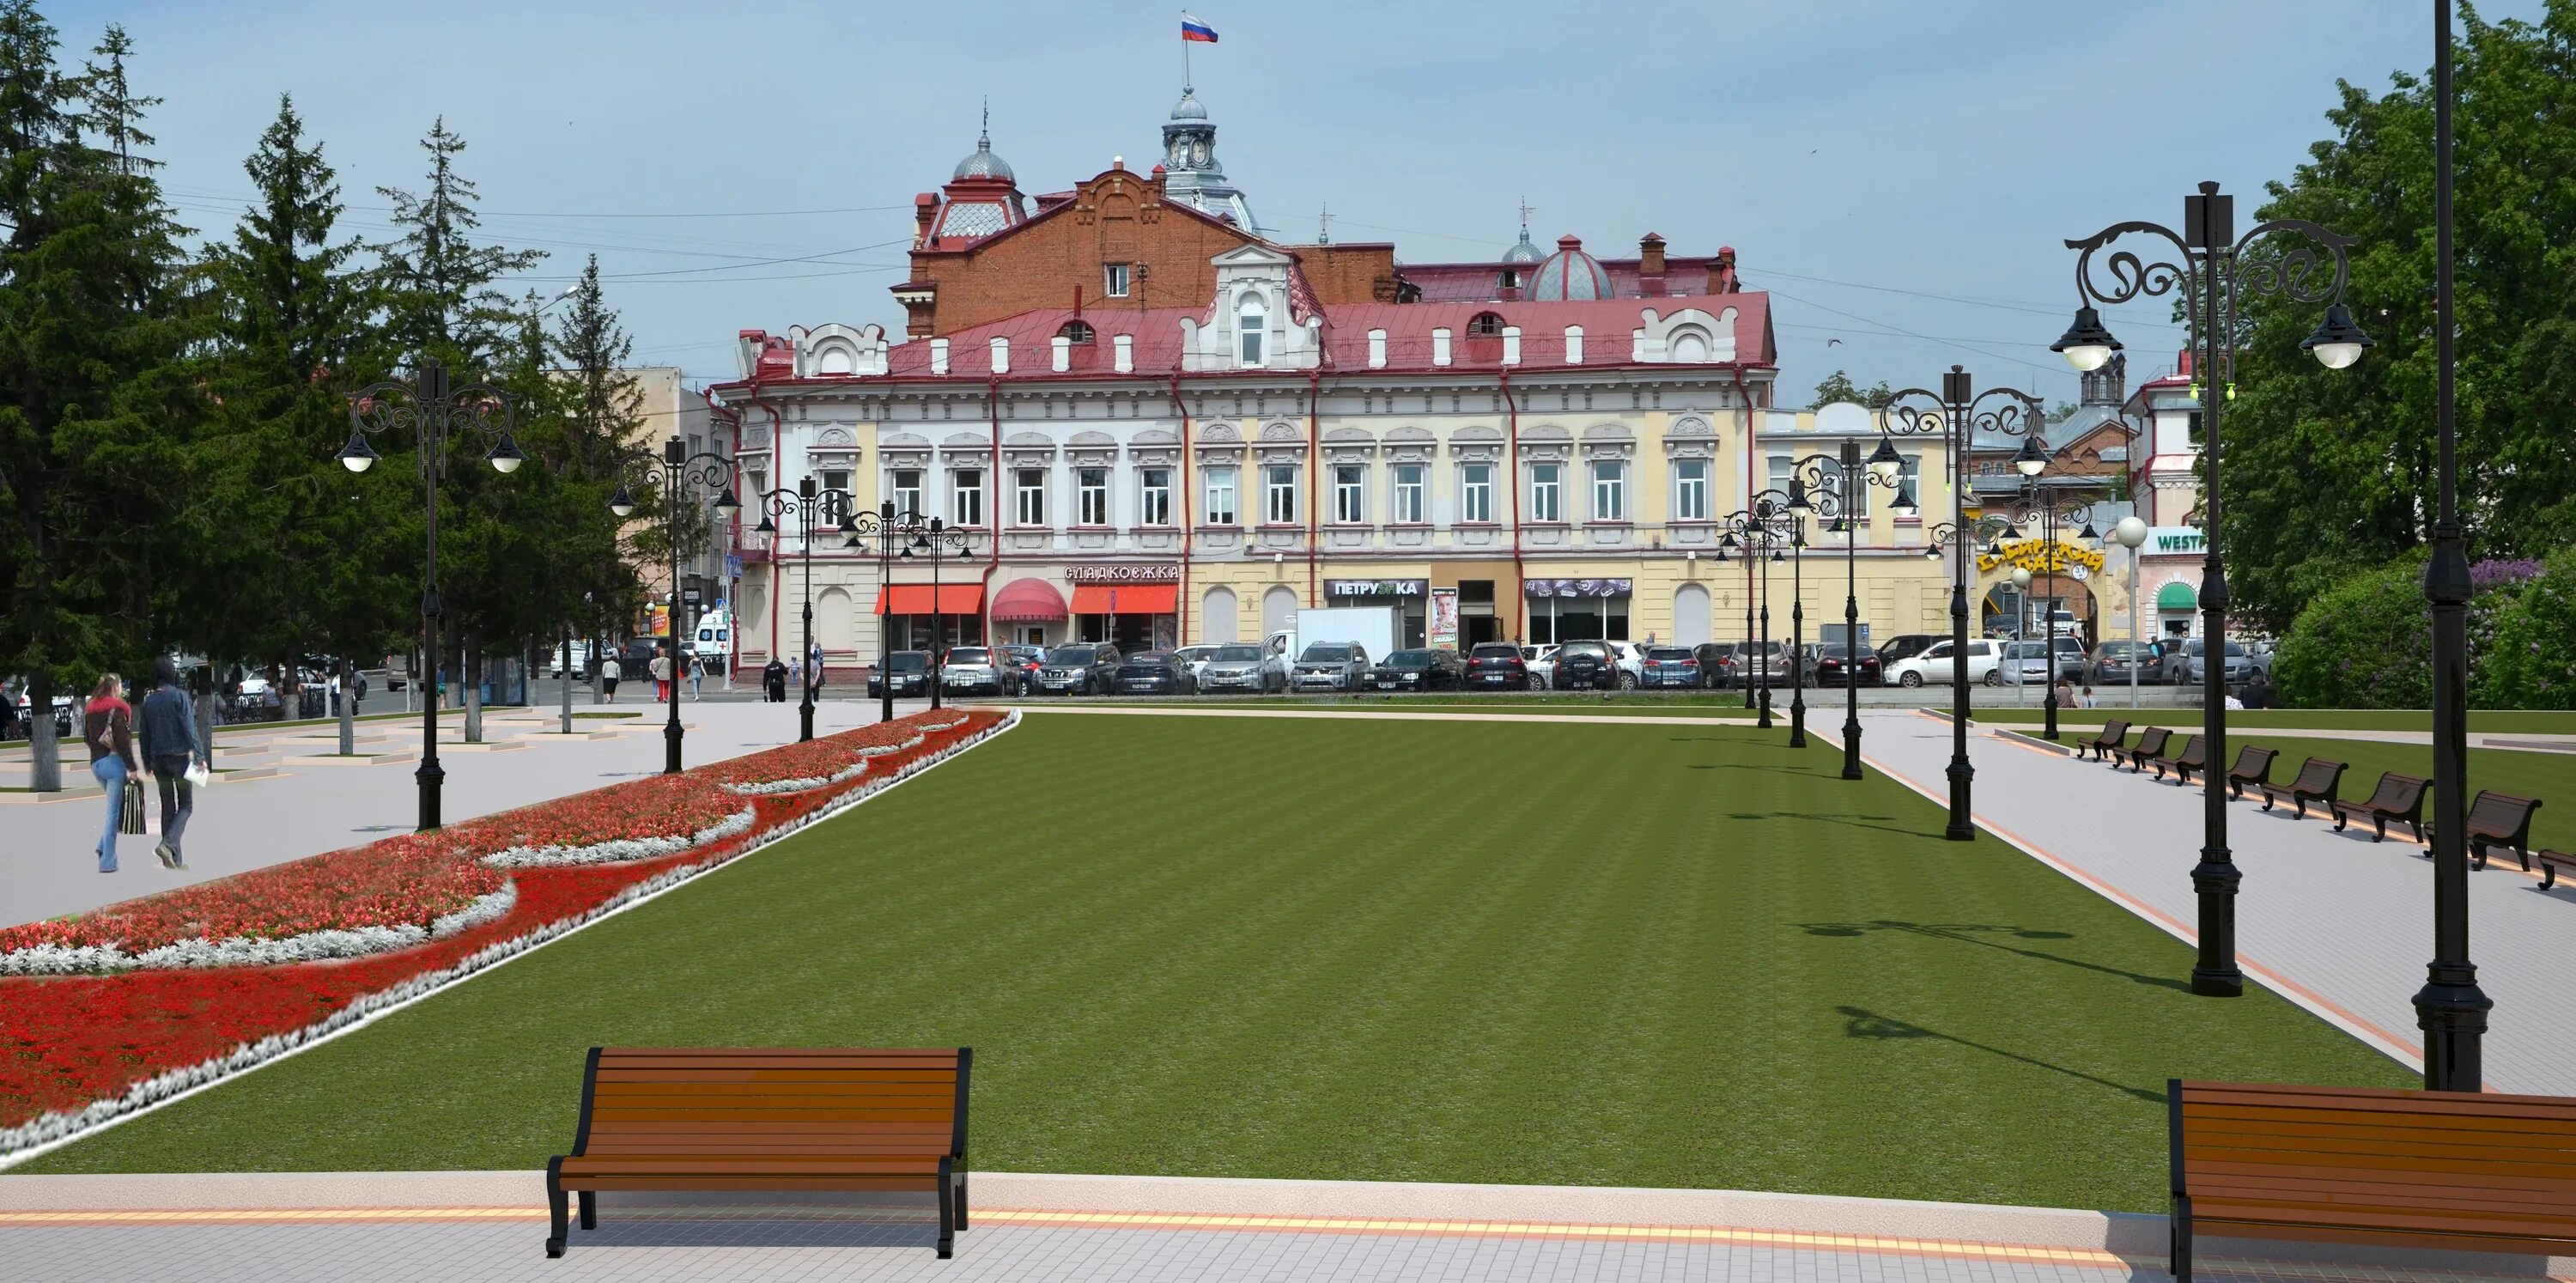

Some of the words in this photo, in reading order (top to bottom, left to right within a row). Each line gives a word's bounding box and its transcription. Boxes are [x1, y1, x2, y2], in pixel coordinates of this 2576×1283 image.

[1977, 539, 2104, 573] СБИРКИЙ
[2015, 556, 2063, 572] ПАБ
[1064, 566, 1179, 580] СЛАДКОЕЖКА
[1334, 582, 1418, 595] ПЕТРУSHКА
